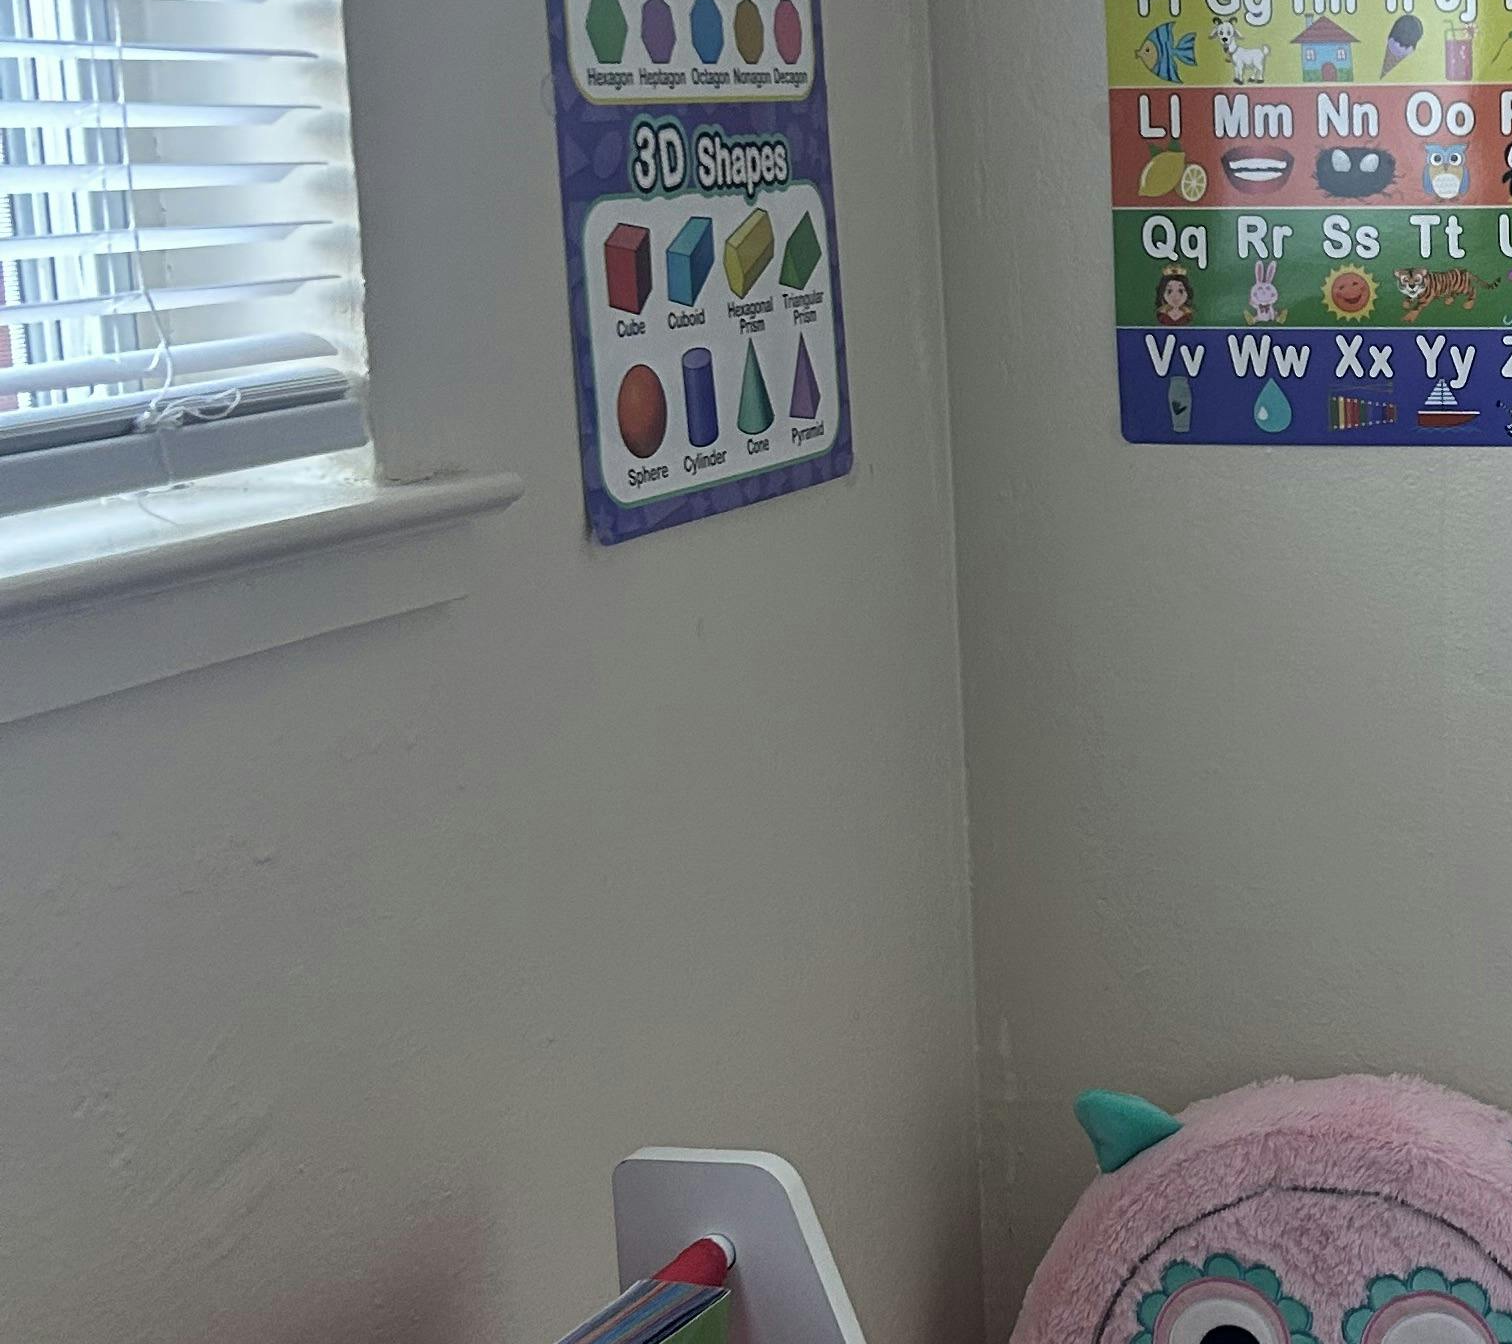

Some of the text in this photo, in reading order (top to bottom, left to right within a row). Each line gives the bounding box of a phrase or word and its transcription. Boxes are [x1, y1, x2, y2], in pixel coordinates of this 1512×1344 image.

[587, 67, 807, 90] Hexagon Heptagon Octagon Nonagon Decagon
[1138, 94, 1182, 139] Ll
[1213, 93, 1293, 138] Mm
[1316, 92, 1379, 137] Nn
[1405, 90, 1476, 136] Oo
[633, 121, 789, 199] 3D Shapes
[1142, 215, 1207, 270] Qq
[1237, 215, 1294, 259] Rr
[1322, 215, 1381, 259] Ss
[1409, 214, 1466, 259] Tt
[616, 290, 824, 338] Cube Cuboid Hexagonal Triangular
[739, 318, 766, 335] Prism
[793, 309, 817, 325] Prism
[1145, 334, 1205, 379] Vv
[1228, 334, 1311, 378] Ww
[1335, 334, 1394, 379] Xx
[1415, 335, 1476, 389] Yy
[628, 421, 825, 489] Sphere Cylinder Cone Pyramid
